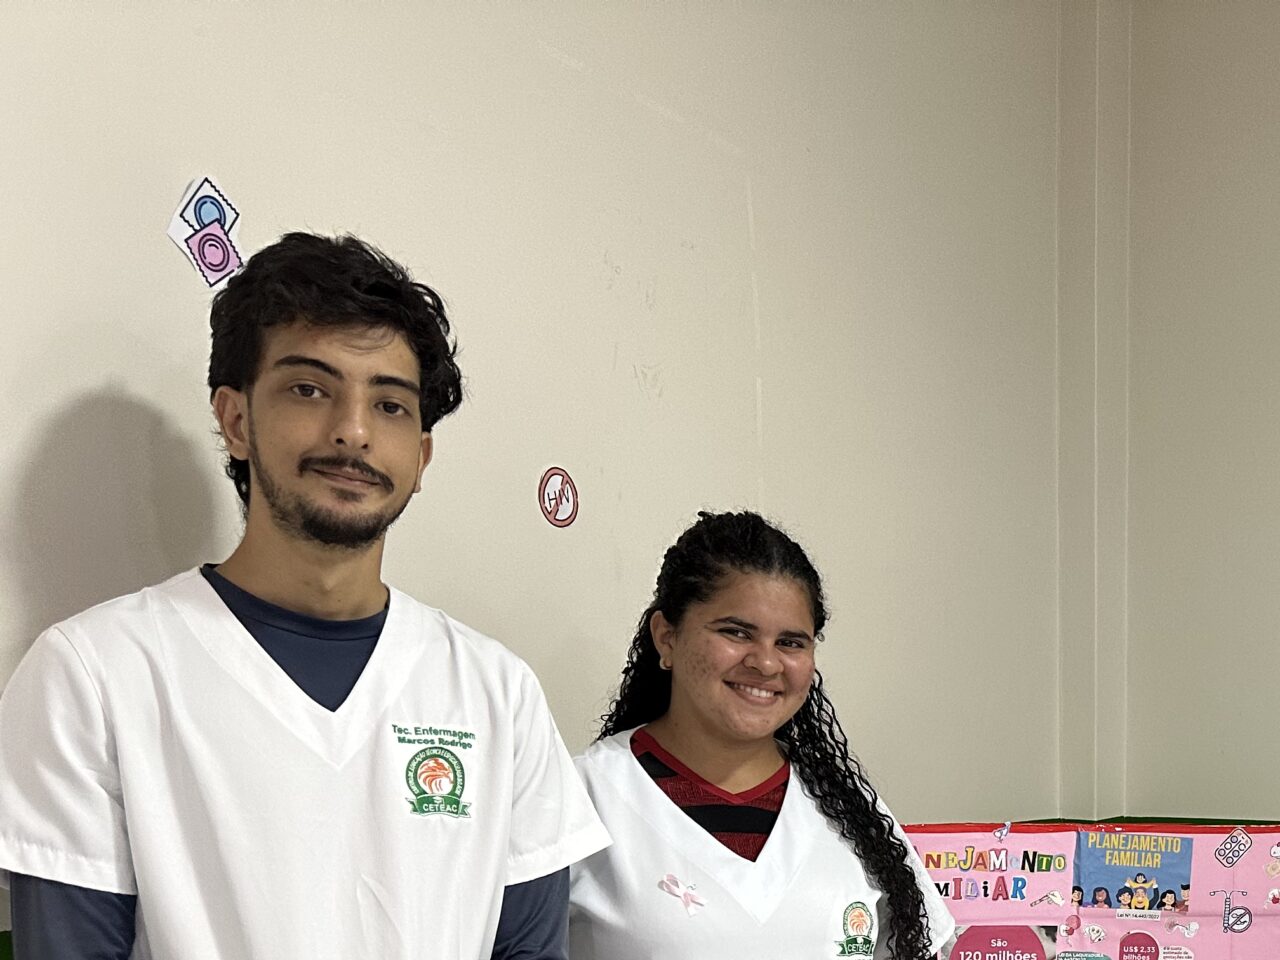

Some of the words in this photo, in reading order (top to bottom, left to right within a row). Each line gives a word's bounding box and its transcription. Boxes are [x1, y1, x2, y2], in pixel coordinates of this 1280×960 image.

[547, 487, 570, 508] HIV
[397, 736, 435, 745] Marcos
[438, 737, 472, 749] Rodrigo
[422, 803, 458, 812] CETEAC
[1088, 832, 1181, 853] PLANEJAMENTO
[1105, 850, 1161, 868] FAMILIAR
[990, 939, 1008, 947] São
[1139, 946, 1155, 954] 2,33
